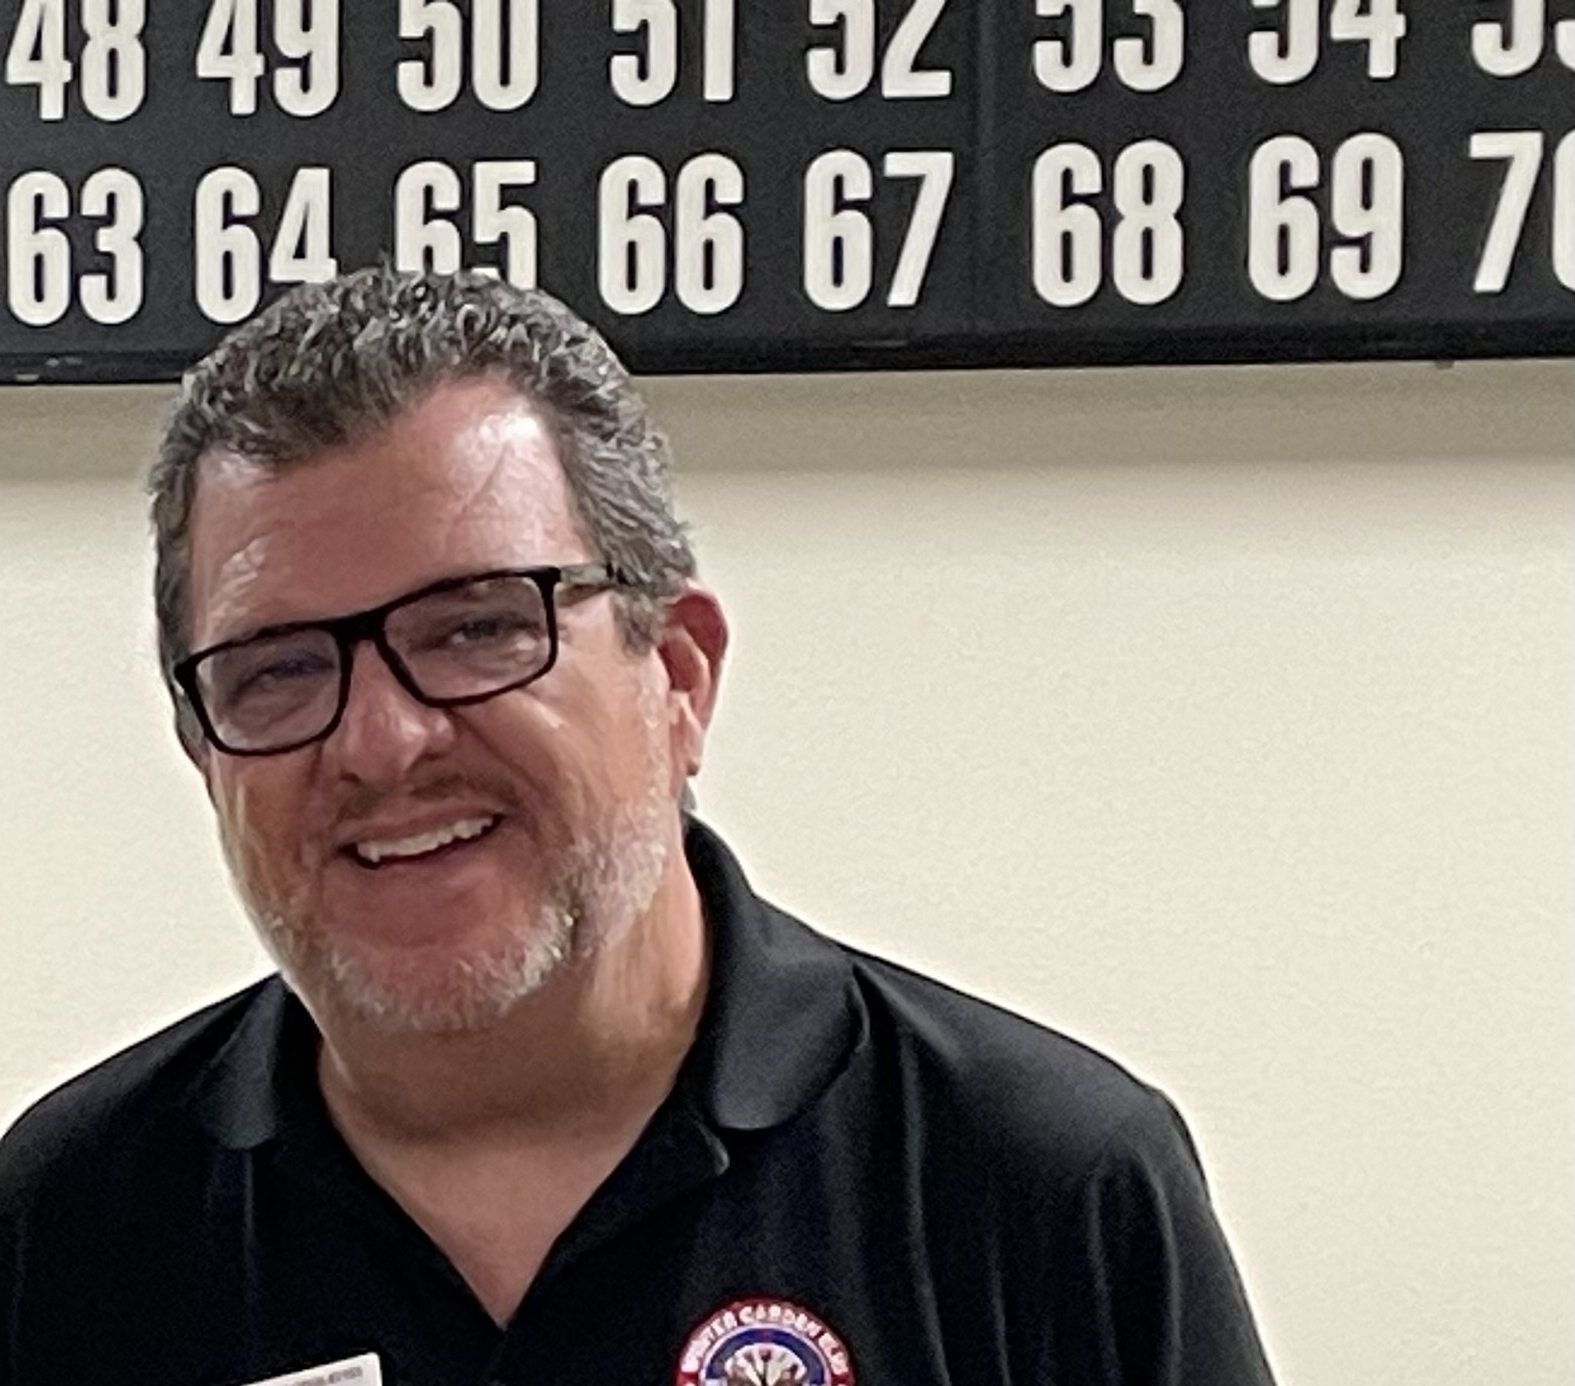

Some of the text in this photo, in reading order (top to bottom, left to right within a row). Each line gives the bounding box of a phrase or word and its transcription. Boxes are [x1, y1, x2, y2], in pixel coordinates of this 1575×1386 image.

[6, 0, 145, 121] 48
[196, 0, 339, 117] 49
[397, 0, 538, 111] 50
[610, 0, 734, 105] 51
[807, 0, 952, 100] 52
[8, 168, 144, 326] 63
[195, 167, 338, 323] 64
[396, 161, 538, 291] 65
[599, 154, 744, 315] 66
[804, 150, 954, 311] 67
[1032, 140, 1184, 307] 68
[1248, 133, 1404, 301] 69
